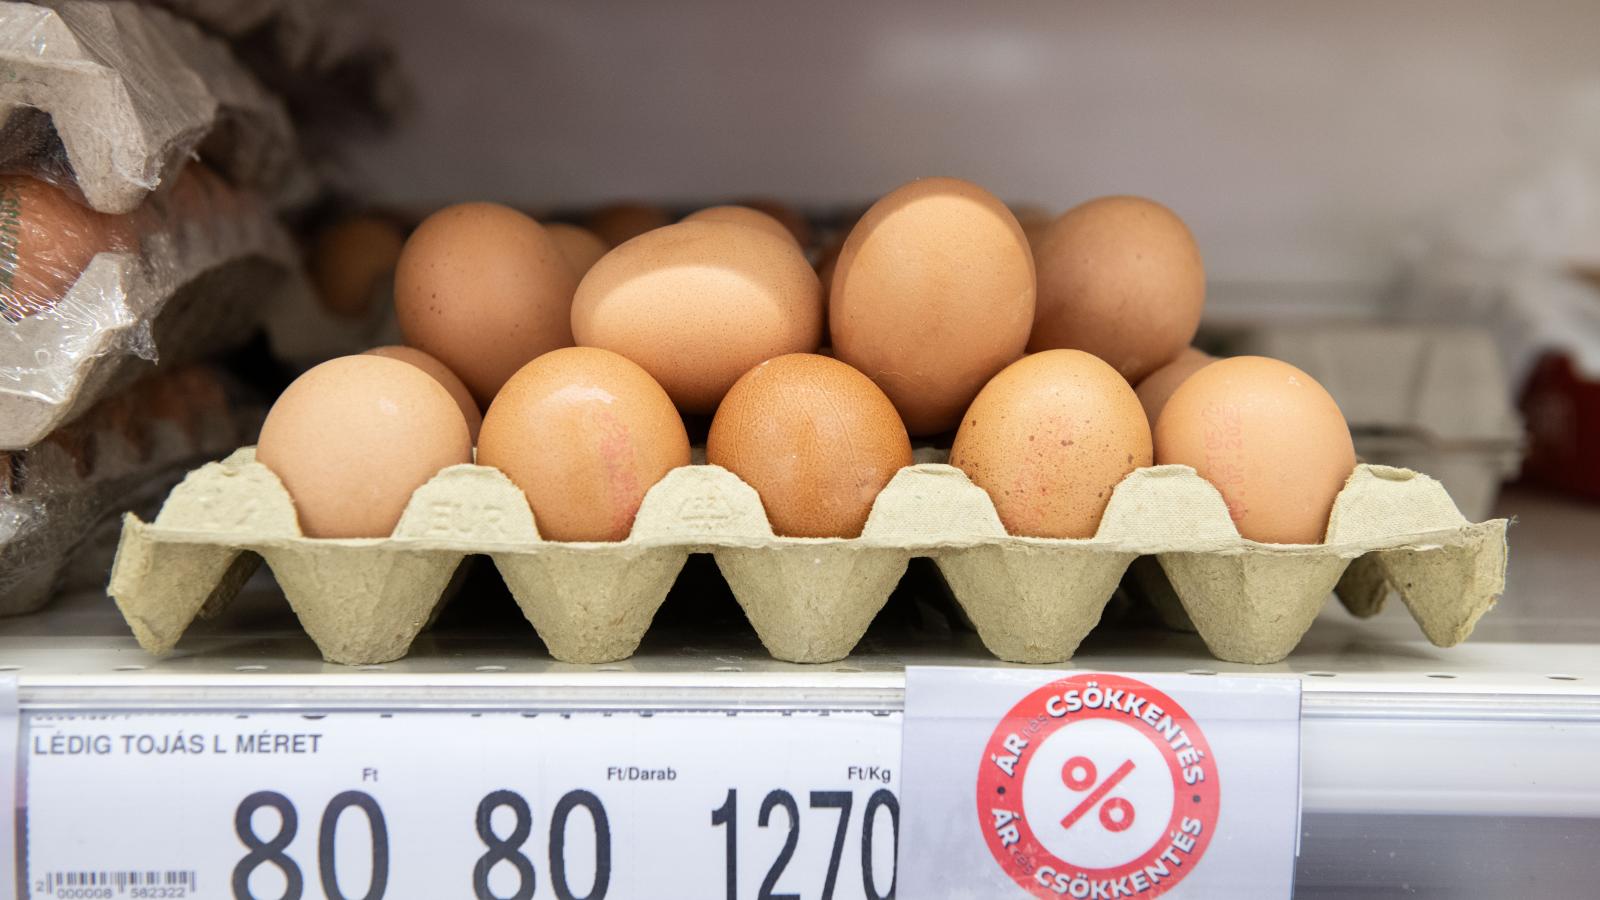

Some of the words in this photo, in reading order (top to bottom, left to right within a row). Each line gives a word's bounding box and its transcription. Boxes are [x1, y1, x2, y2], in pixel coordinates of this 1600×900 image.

[35, 731, 111, 755] LÉDIG
[122, 730, 204, 755] TOJÁS
[213, 735, 227, 754] L
[237, 729, 323, 754] MÉRET
[362, 768, 378, 782] Ft
[607, 766, 677, 781] Ft/Darab
[847, 766, 891, 784] Ft/Kg
[232, 790, 389, 900] 80
[473, 789, 612, 900] 80
[711, 788, 899, 900] 1270
